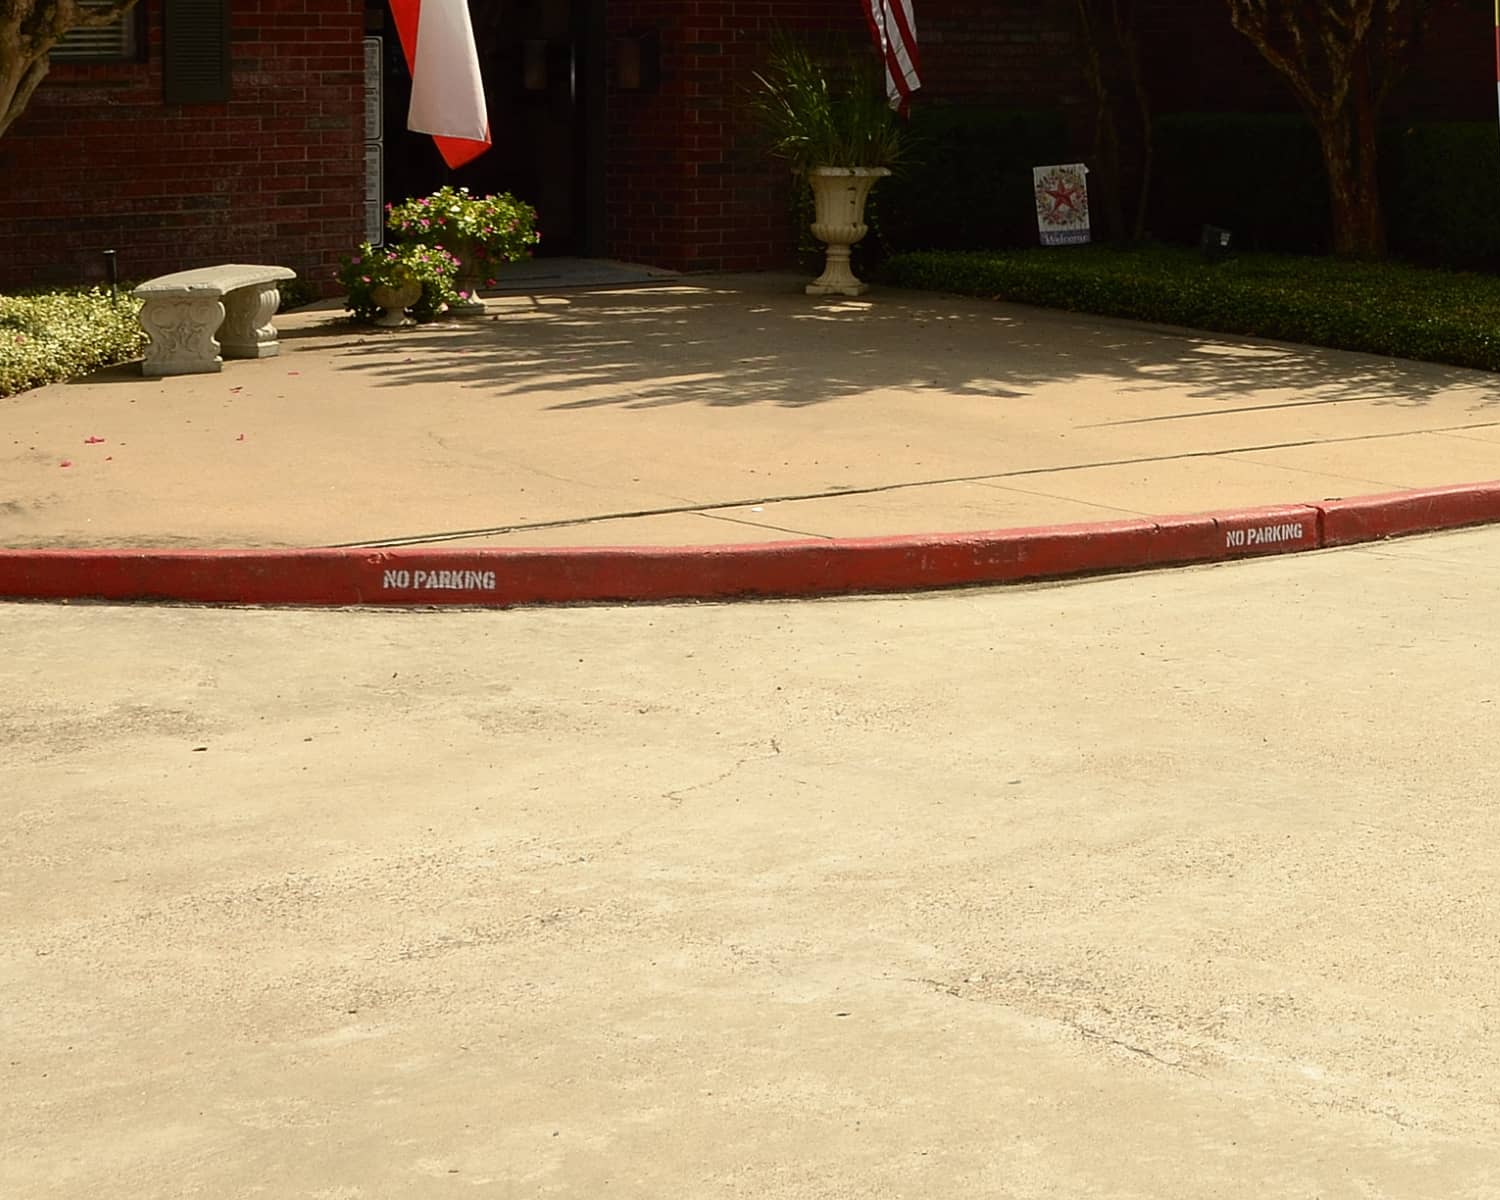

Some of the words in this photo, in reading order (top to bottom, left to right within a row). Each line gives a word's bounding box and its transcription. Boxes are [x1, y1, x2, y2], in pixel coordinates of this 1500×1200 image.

[1226, 530, 1244, 548] NO
[1247, 523, 1303, 545] PARKING
[383, 569, 409, 588] NO
[413, 569, 496, 589] PARKING
